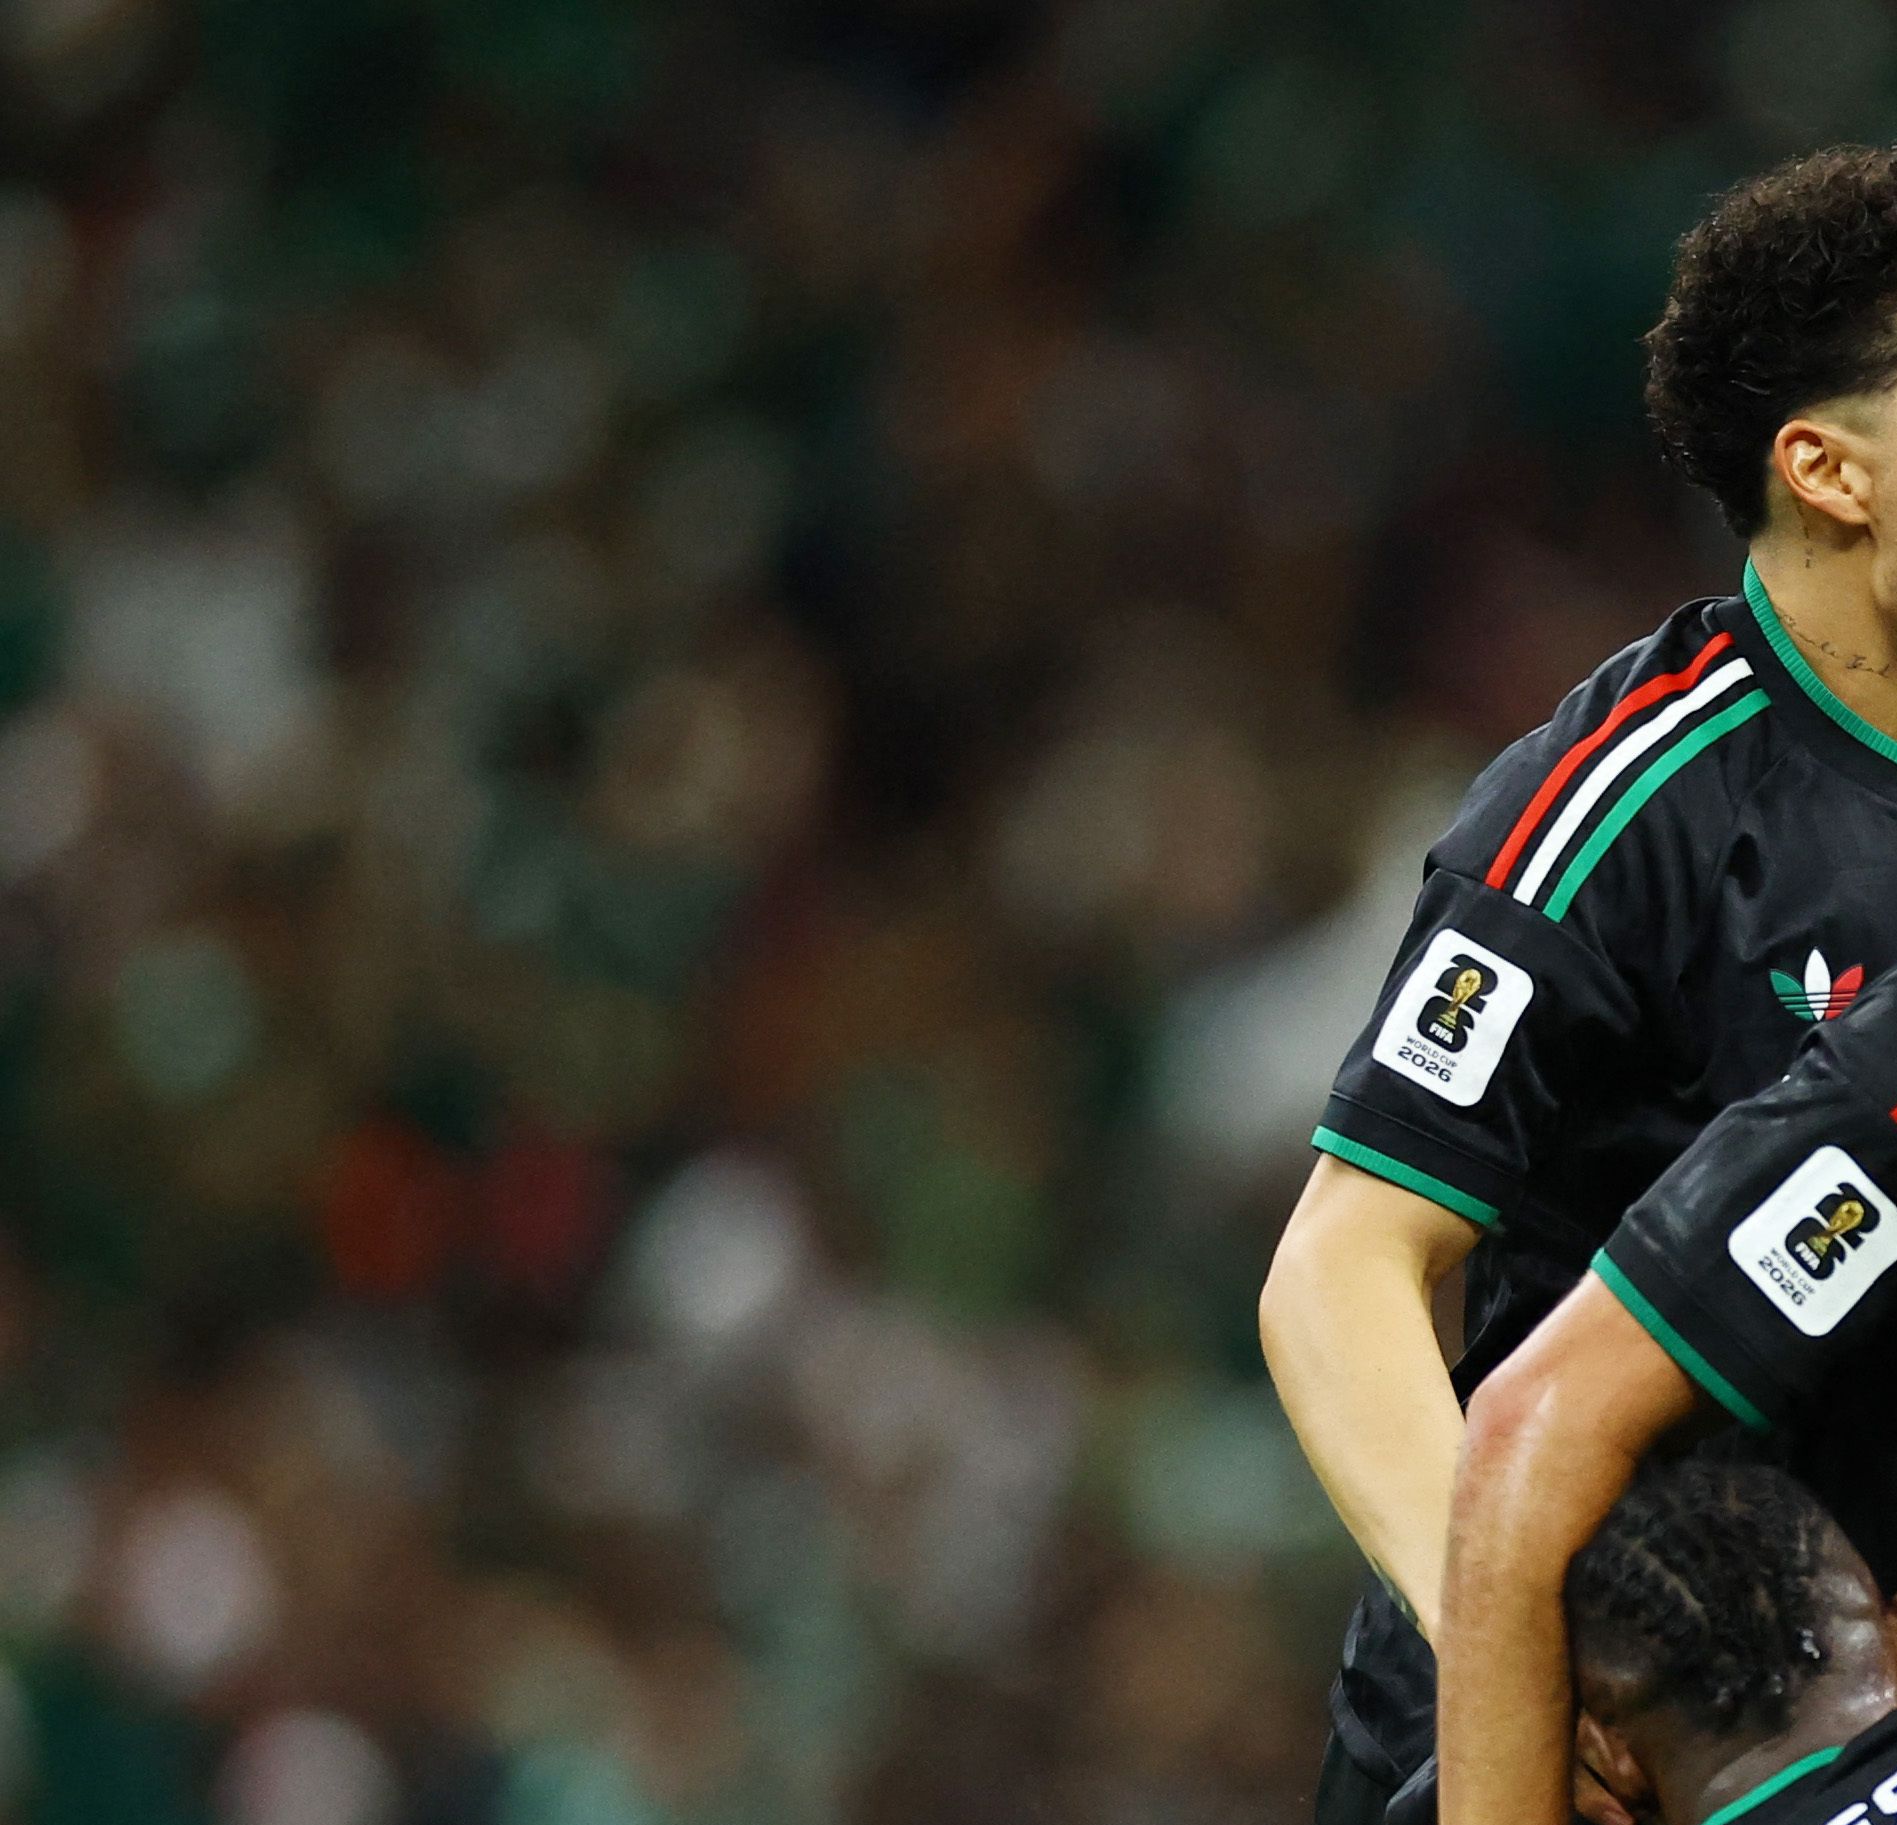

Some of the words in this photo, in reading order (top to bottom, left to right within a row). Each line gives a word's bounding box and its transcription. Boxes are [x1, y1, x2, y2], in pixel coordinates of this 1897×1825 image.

[1429, 1022, 1455, 1044] FIFA
[1397, 1046, 1453, 1083] 2026
[1406, 1035, 1439, 1059] WORLD
[1439, 1054, 1458, 1068] CUP
[1795, 1241, 1821, 1271] FIFA
[1758, 1255, 1806, 1306] 2026
